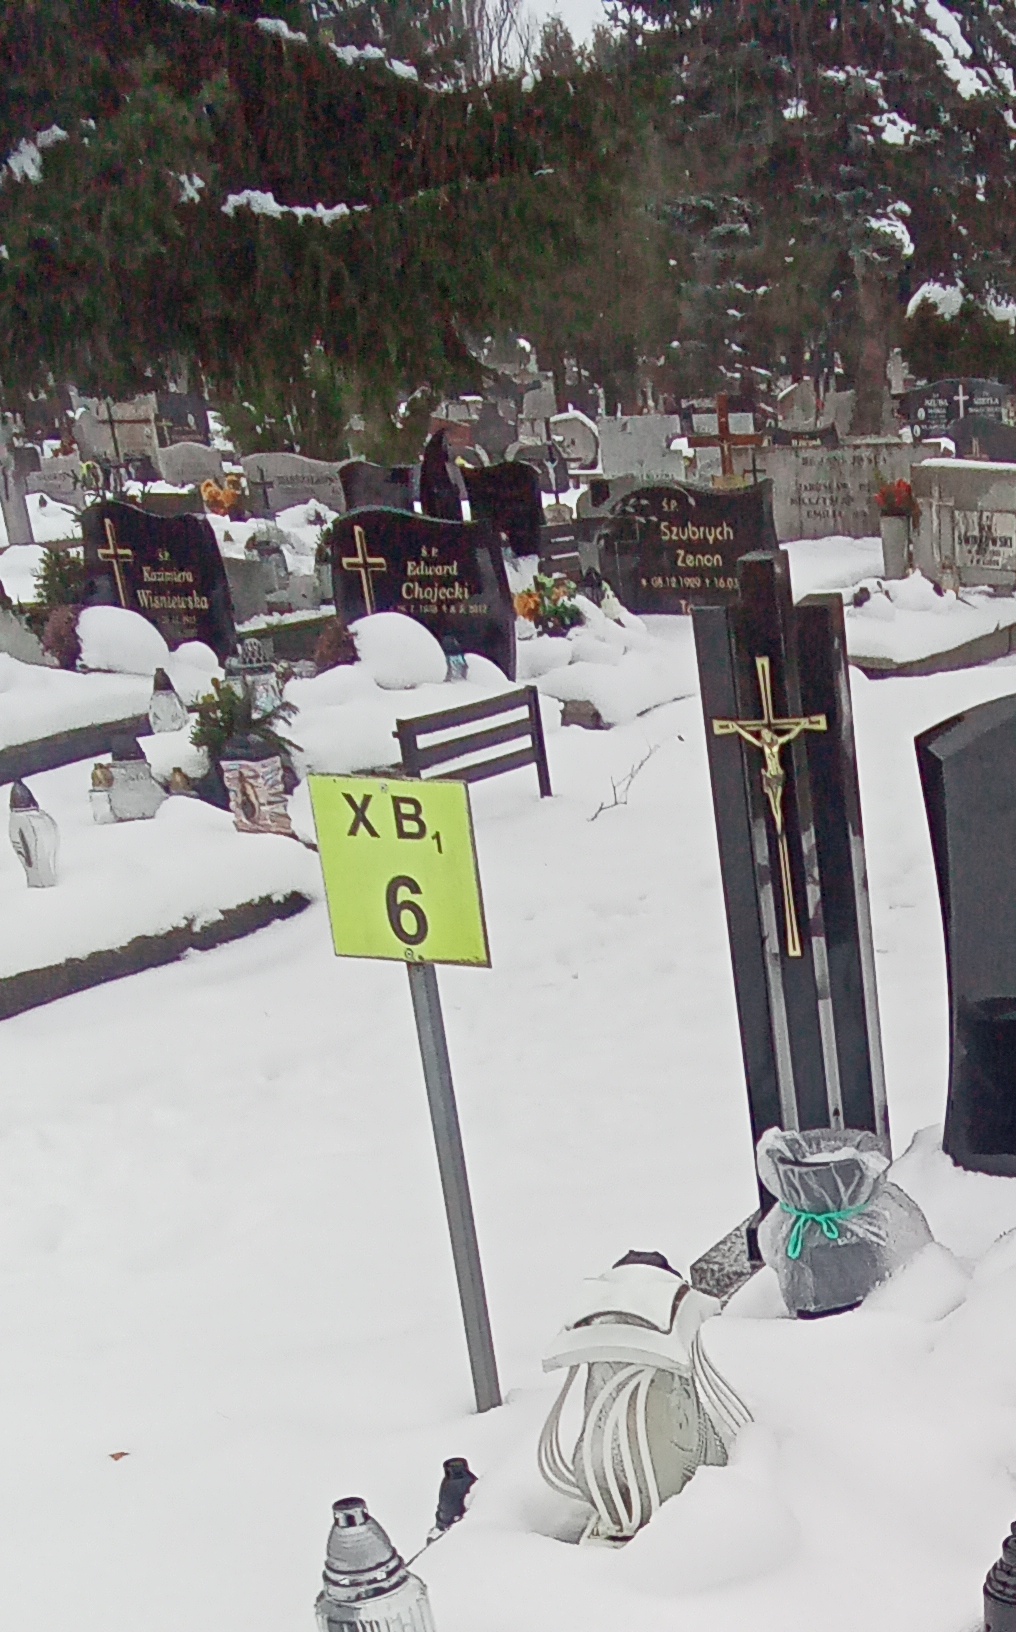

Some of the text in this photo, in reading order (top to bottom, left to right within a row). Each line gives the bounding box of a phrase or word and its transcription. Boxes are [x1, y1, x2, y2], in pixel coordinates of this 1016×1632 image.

[660, 521, 734, 545] Szubrych
[406, 559, 459, 577] Edward
[676, 549, 723, 568] Zenon
[142, 566, 194, 583] Kazimiera
[401, 580, 470, 604] Chojecki
[385, 874, 429, 946] 6
